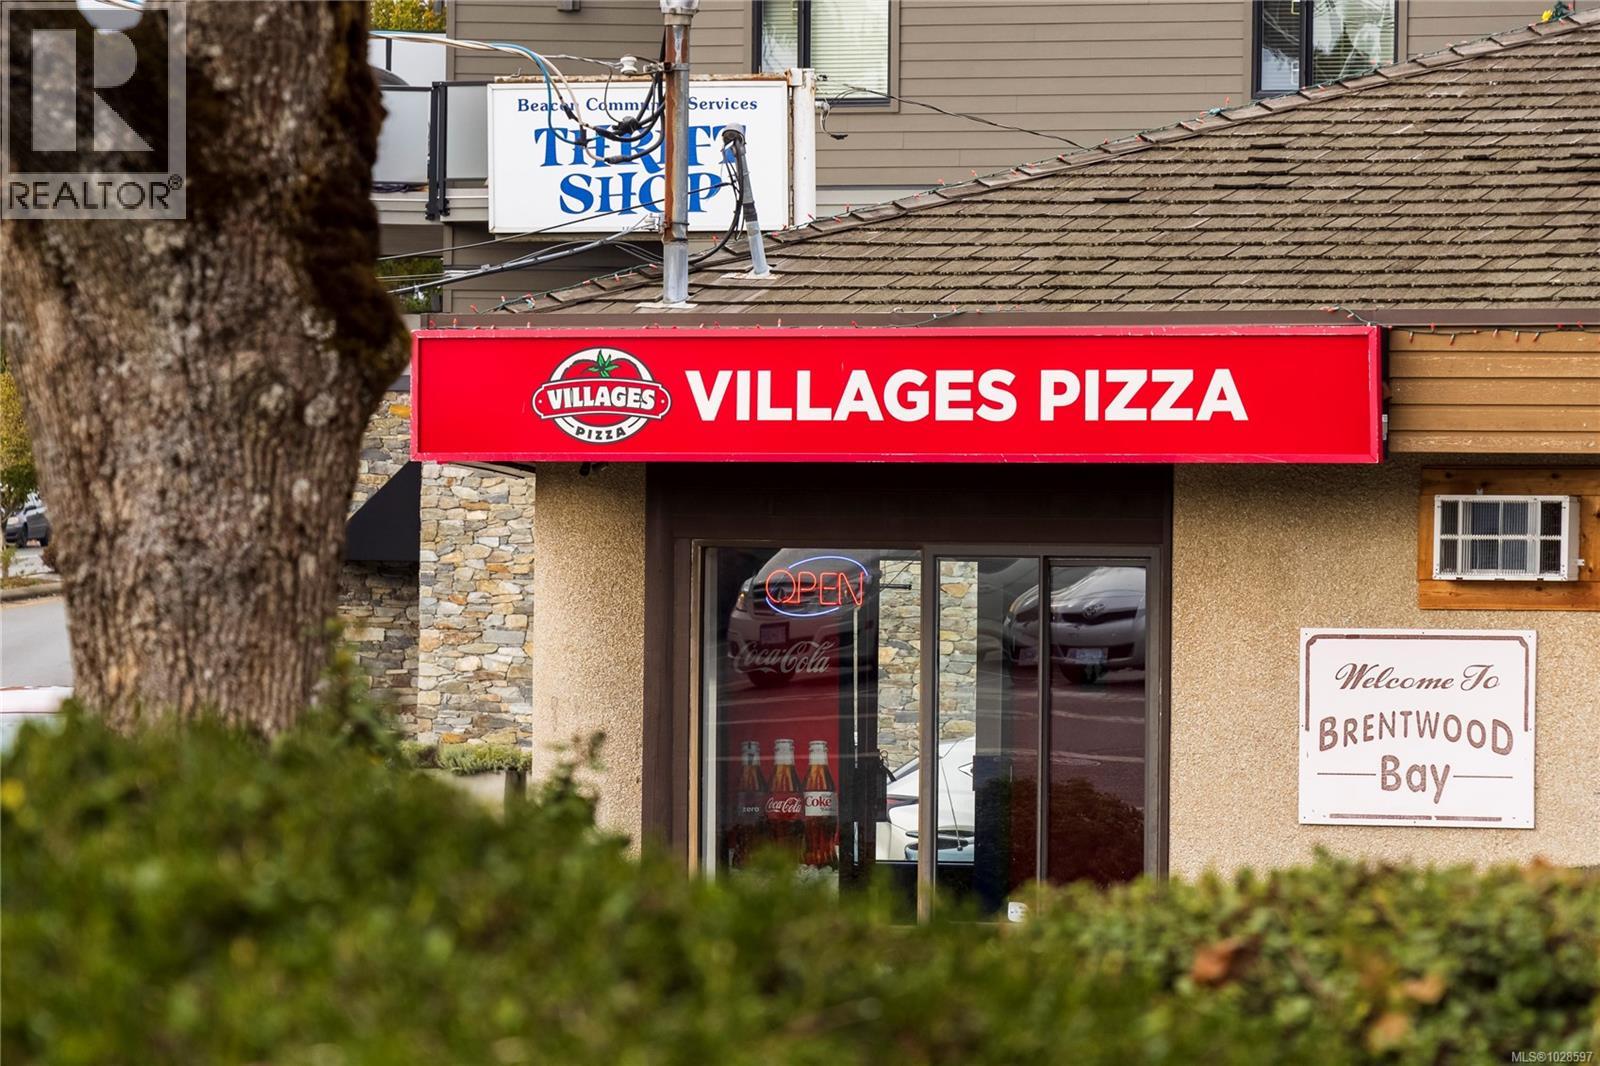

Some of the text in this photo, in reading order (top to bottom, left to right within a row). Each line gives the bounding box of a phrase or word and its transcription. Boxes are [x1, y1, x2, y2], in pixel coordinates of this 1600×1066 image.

[586, 97, 665, 112] Commun
[688, 96, 758, 111] Services
[560, 171, 722, 215] SHOP
[547, 386, 655, 410] VILLAGES
[685, 368, 1249, 422] VILLAGES PIZZA
[575, 426, 626, 440] PIZZA
[765, 568, 864, 606] OPEN
[1335, 662, 1500, 691] Welcome To
[1319, 710, 1513, 755] BRENTWOOD
[1381, 754, 1450, 804] Bay
[742, 805, 760, 814] zero
[804, 795, 832, 808] Coke
